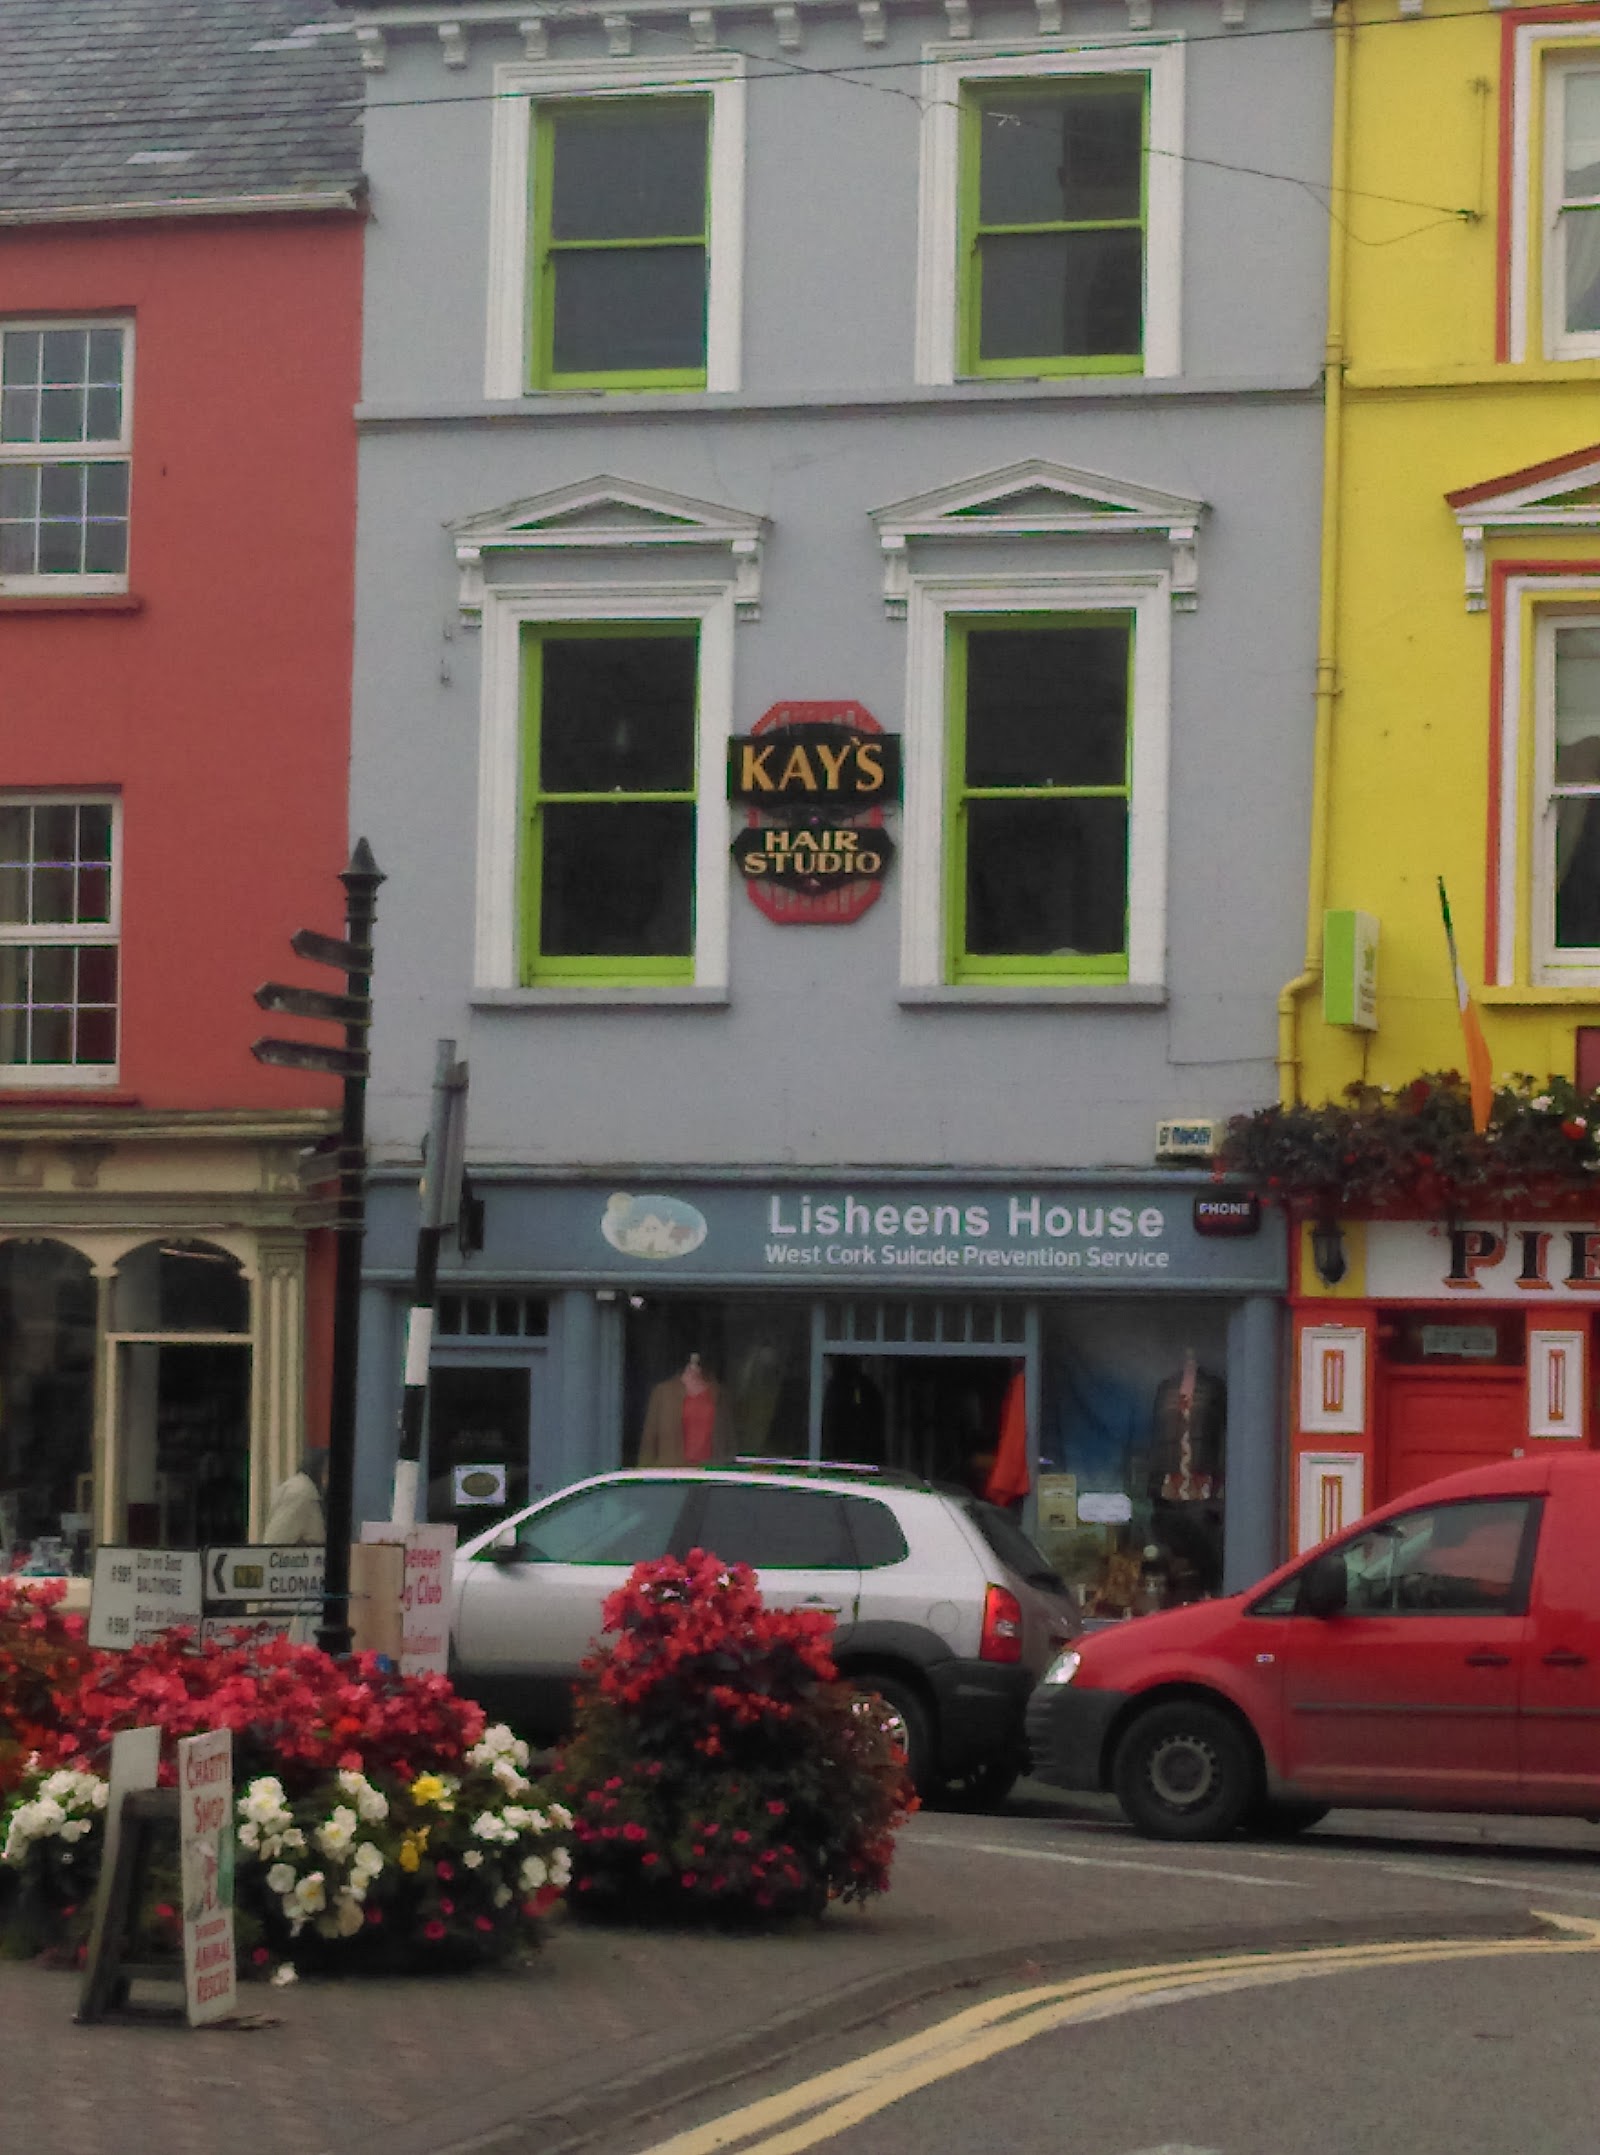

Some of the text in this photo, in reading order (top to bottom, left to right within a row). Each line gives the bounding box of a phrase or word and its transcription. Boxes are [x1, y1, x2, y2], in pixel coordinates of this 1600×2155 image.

[741, 736, 885, 792] KAY'S
[764, 829, 859, 852] HAIR
[744, 851, 882, 875] STUDIO
[769, 1195, 1165, 1238] Lisheens House
[1199, 1202, 1250, 1216] PHONE
[765, 1244, 1170, 1268] West Cork Suicide Prevention Service
